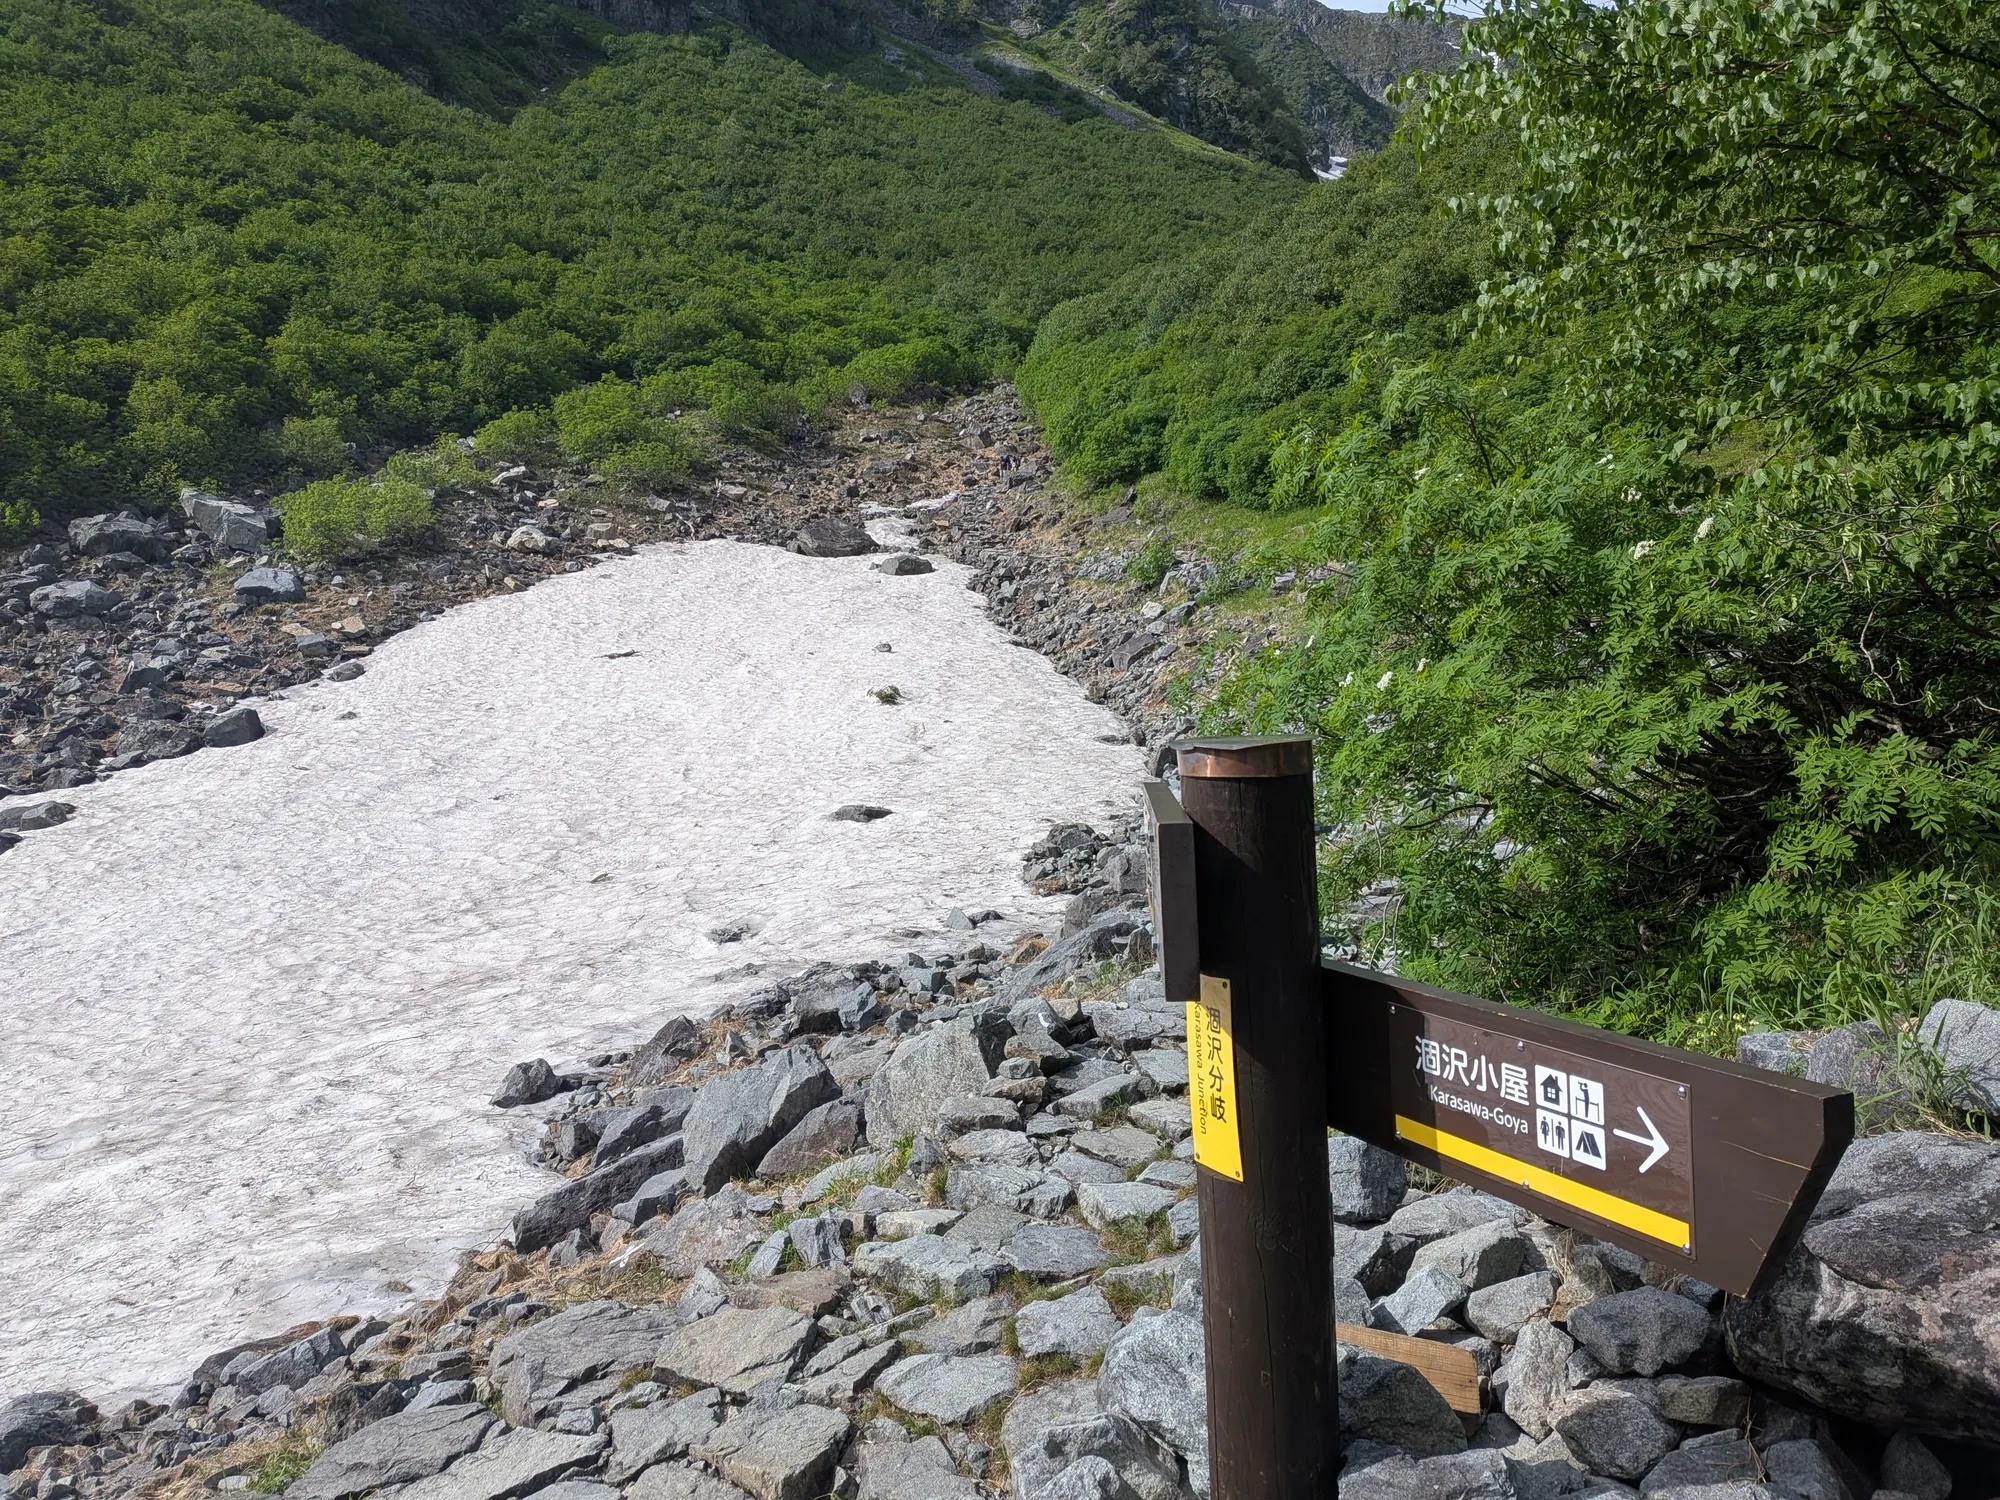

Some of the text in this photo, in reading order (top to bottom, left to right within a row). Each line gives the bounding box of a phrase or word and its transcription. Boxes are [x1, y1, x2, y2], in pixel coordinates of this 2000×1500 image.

[1194, 1001, 1207, 1135] Karasawa Junction
[1206, 1005, 1227, 1124] 涸沢分岐
[1415, 1035, 1529, 1106] 涸沢小屋
[1430, 1084, 1529, 1134] Karasawa-Goya
